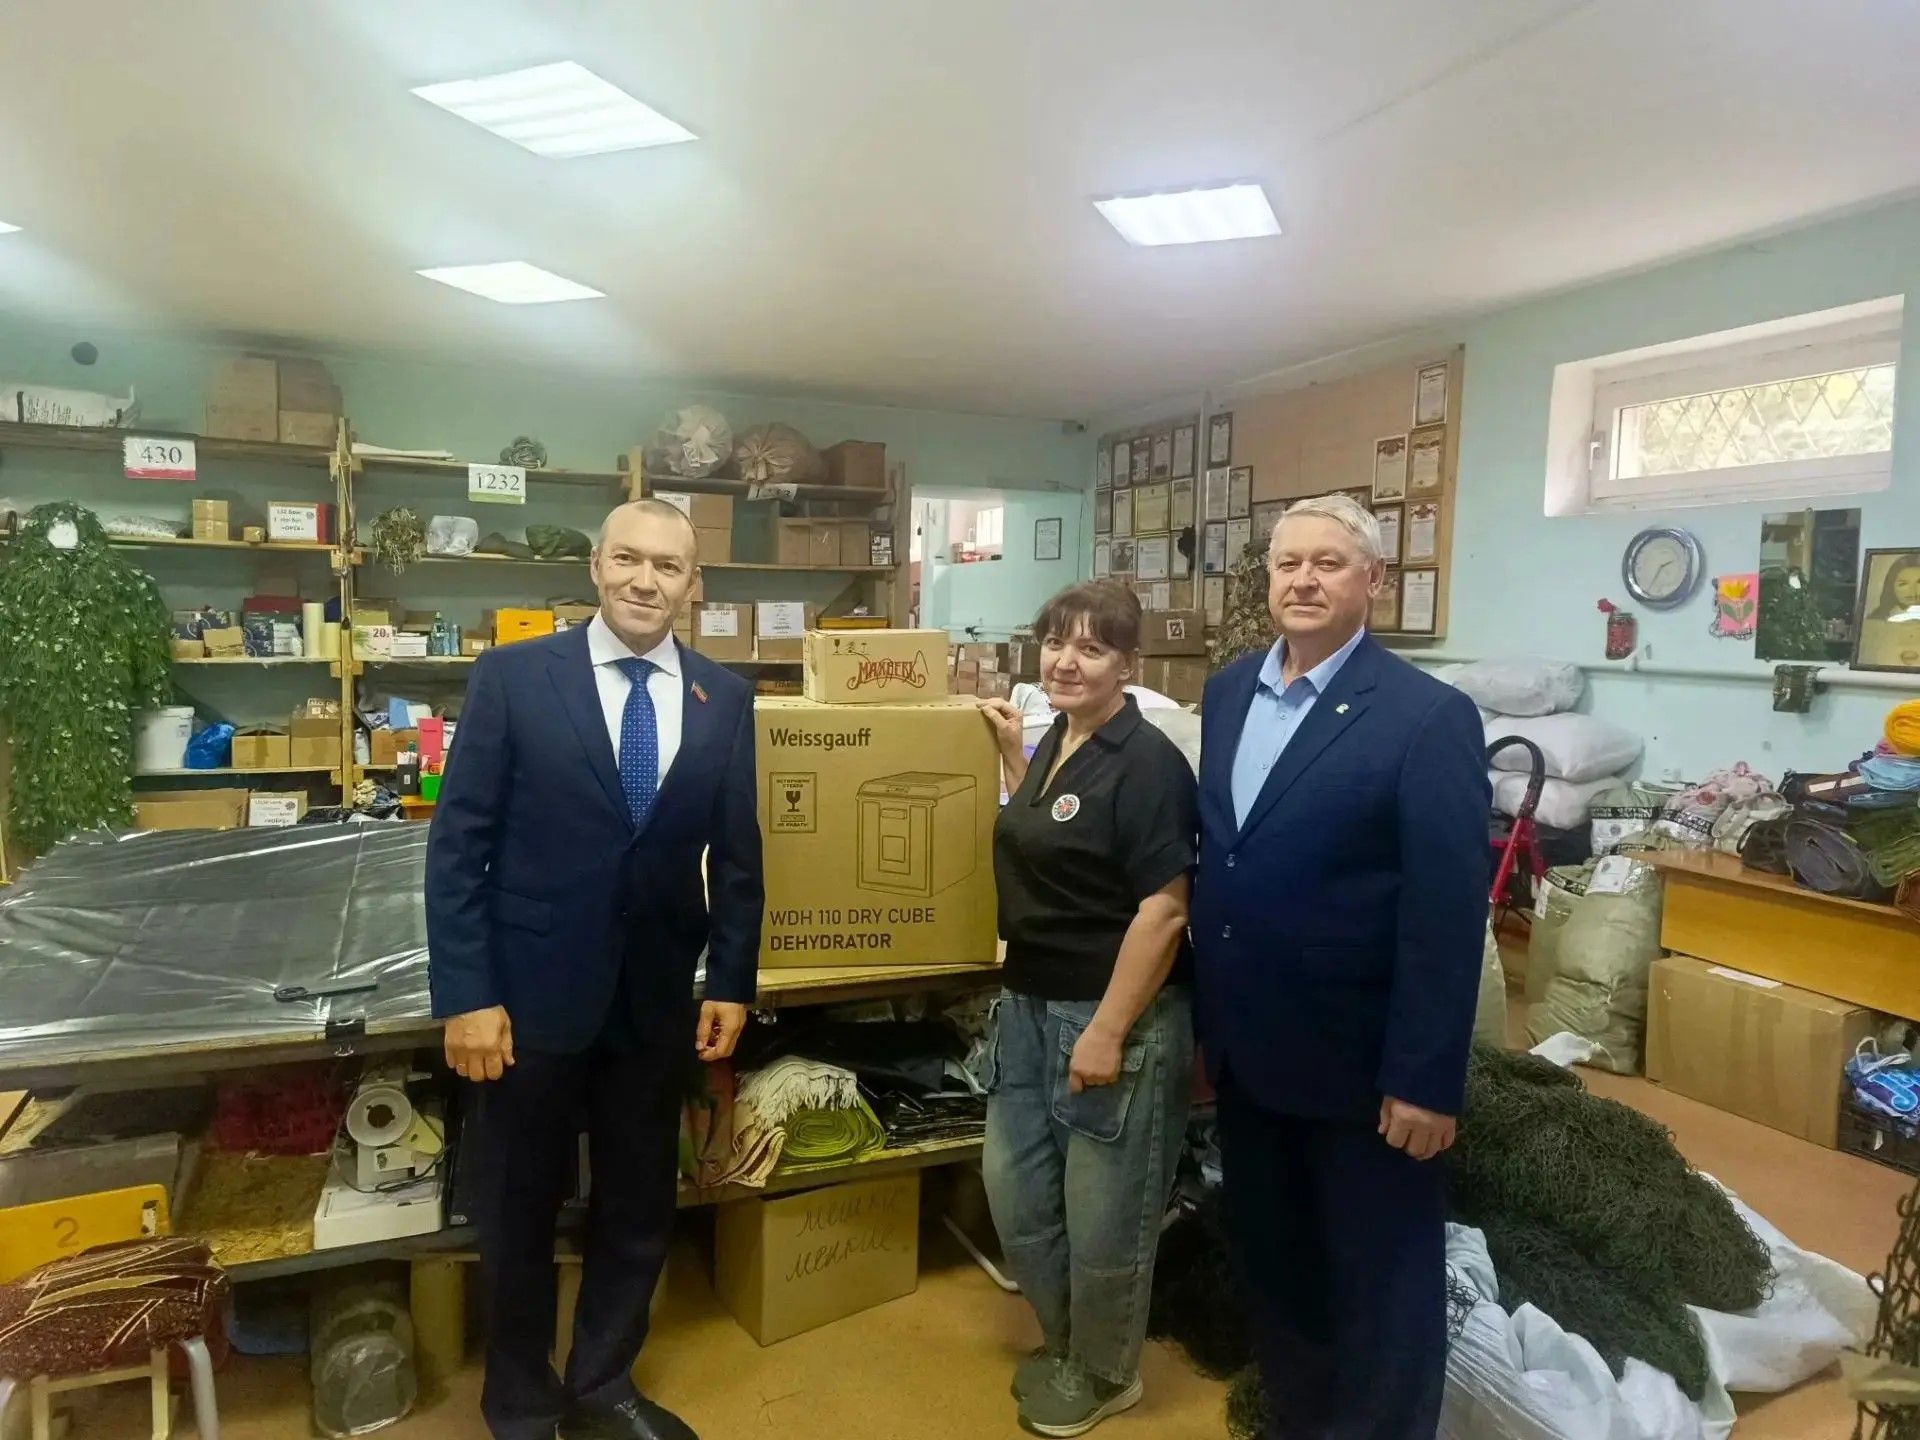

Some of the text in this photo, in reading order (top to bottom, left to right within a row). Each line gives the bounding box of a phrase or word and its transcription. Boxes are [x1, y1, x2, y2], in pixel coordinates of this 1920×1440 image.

[141, 446, 182, 464] 430
[478, 473, 520, 490] 1232
[769, 728, 871, 751] Weissgauff
[769, 907, 936, 926] WDH 110 DRY CUBE
[770, 933, 892, 951] DEHYDRATOR
[53, 1216, 80, 1249] 2
